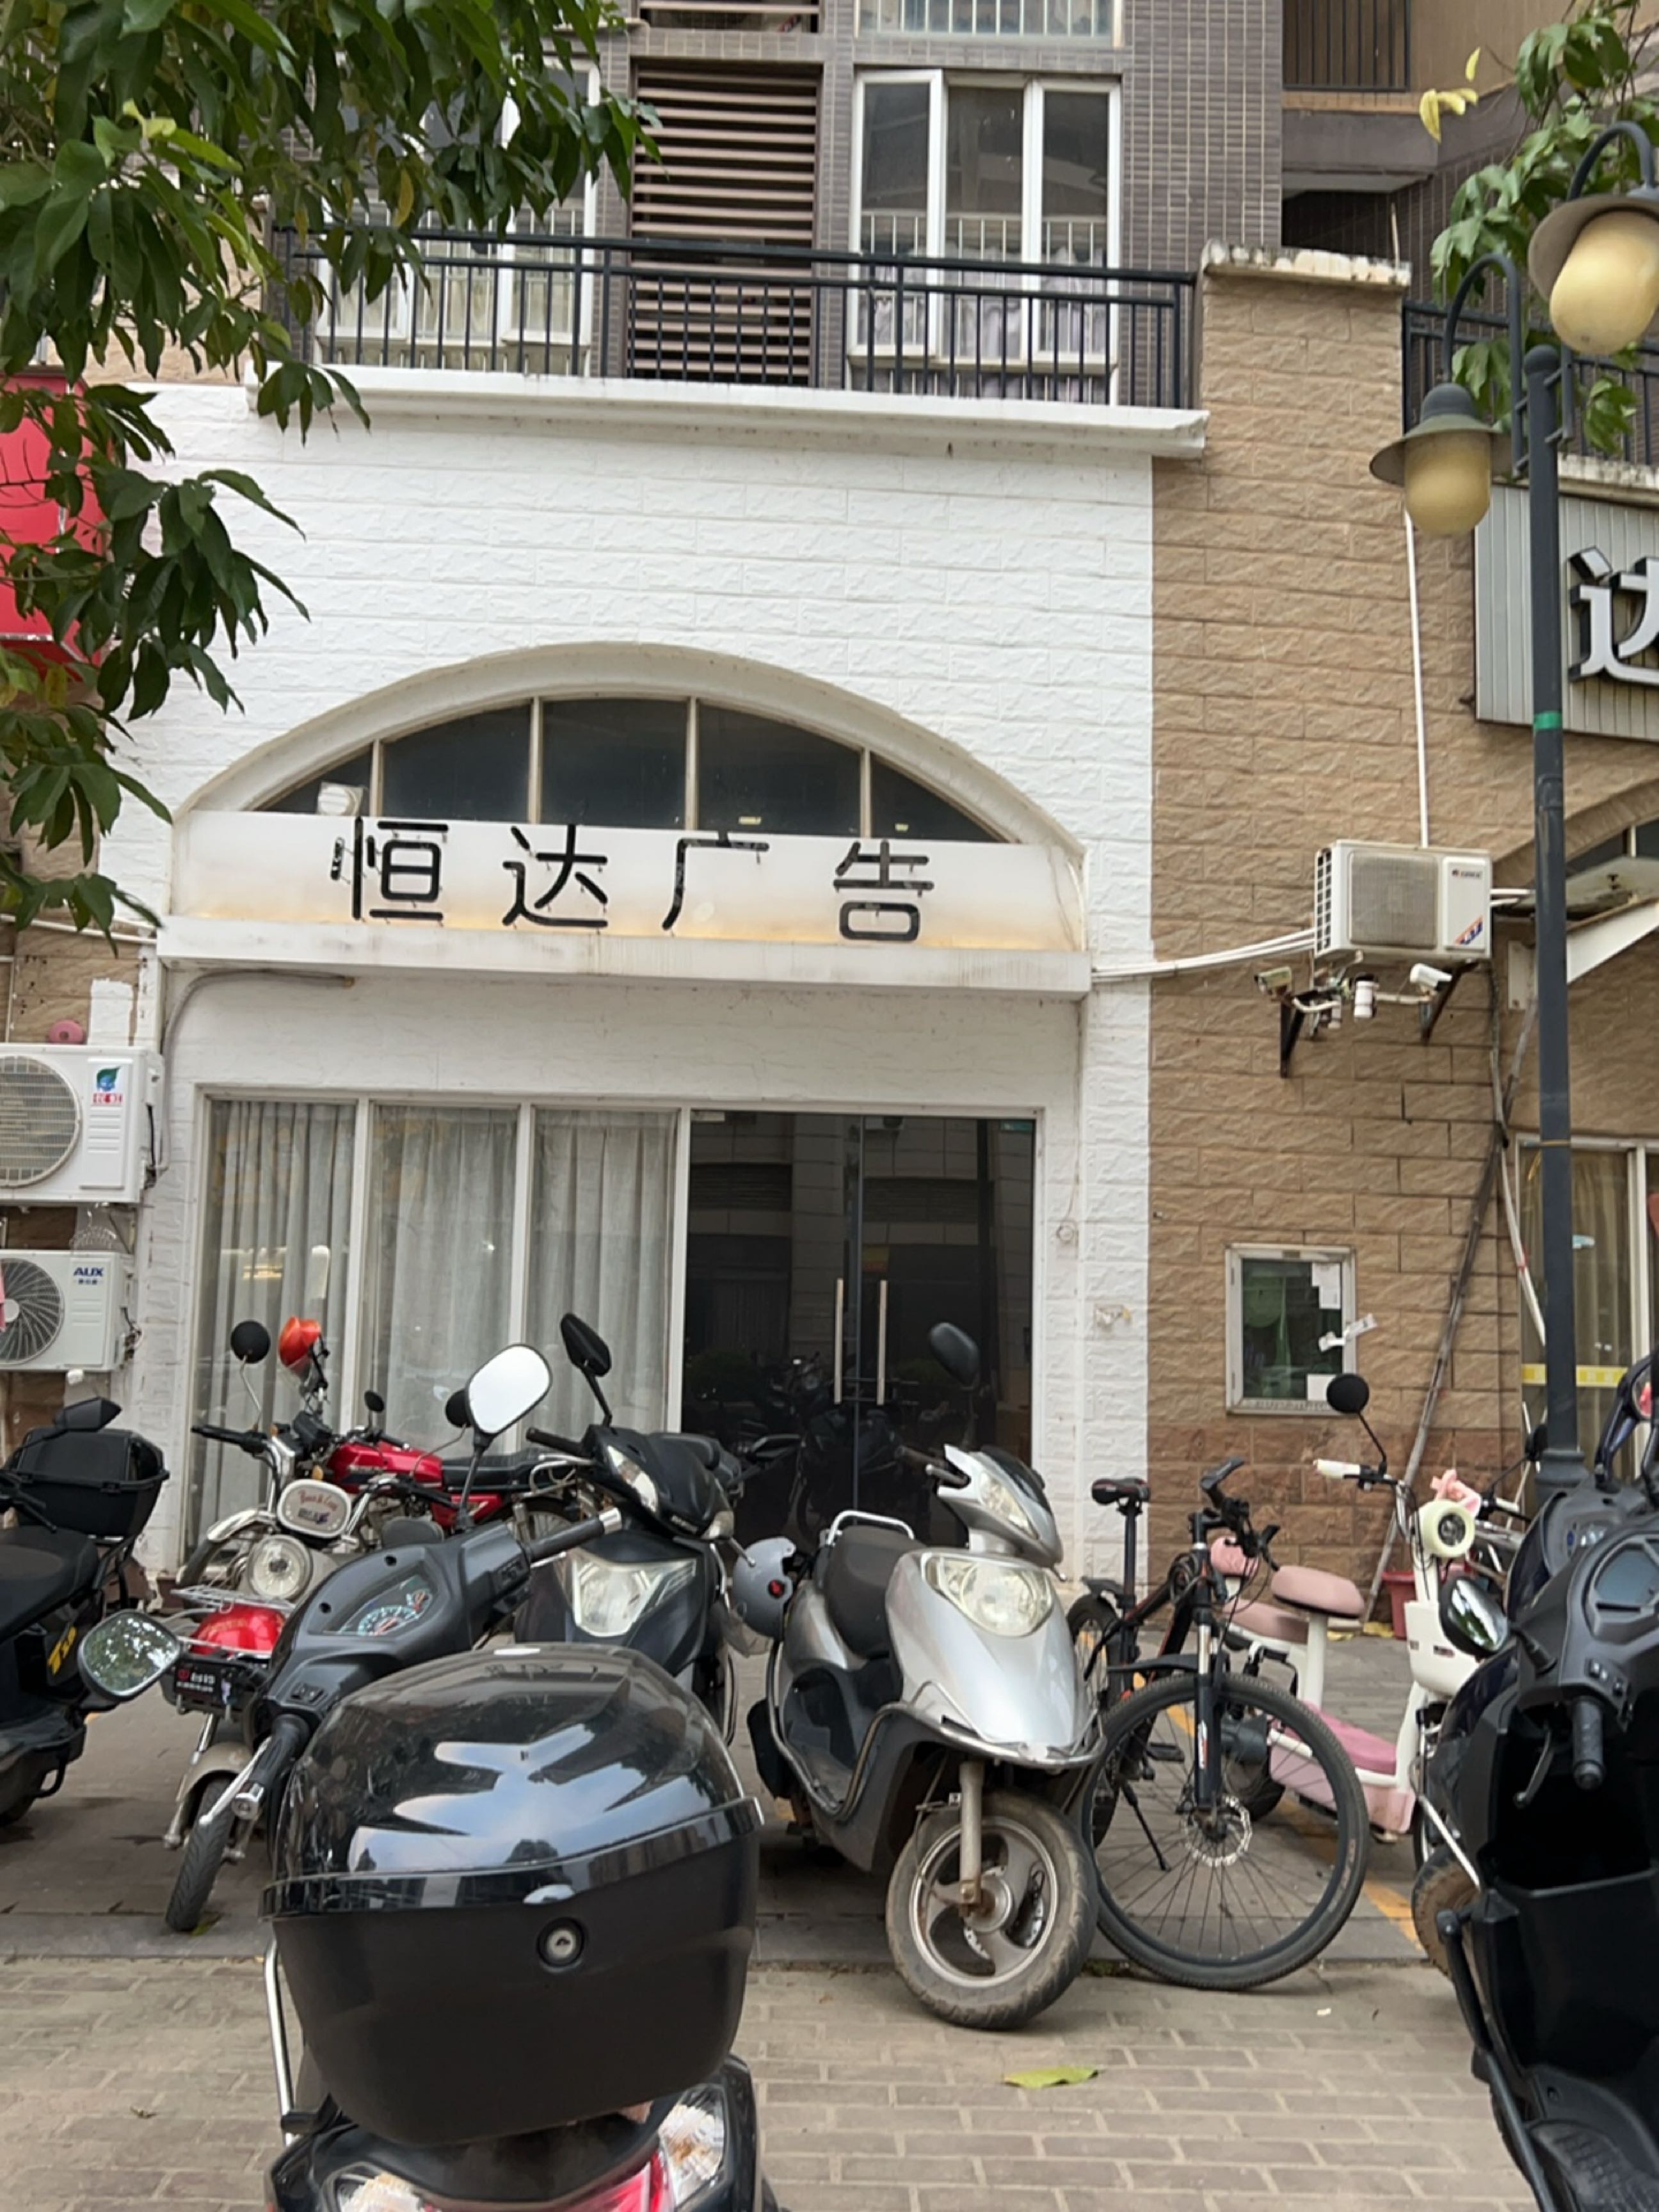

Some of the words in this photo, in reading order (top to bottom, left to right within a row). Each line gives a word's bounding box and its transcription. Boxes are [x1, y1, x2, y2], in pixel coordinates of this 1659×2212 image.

[330, 816, 934, 942] 恒达广告
[73, 1267, 104, 1277] AUX
